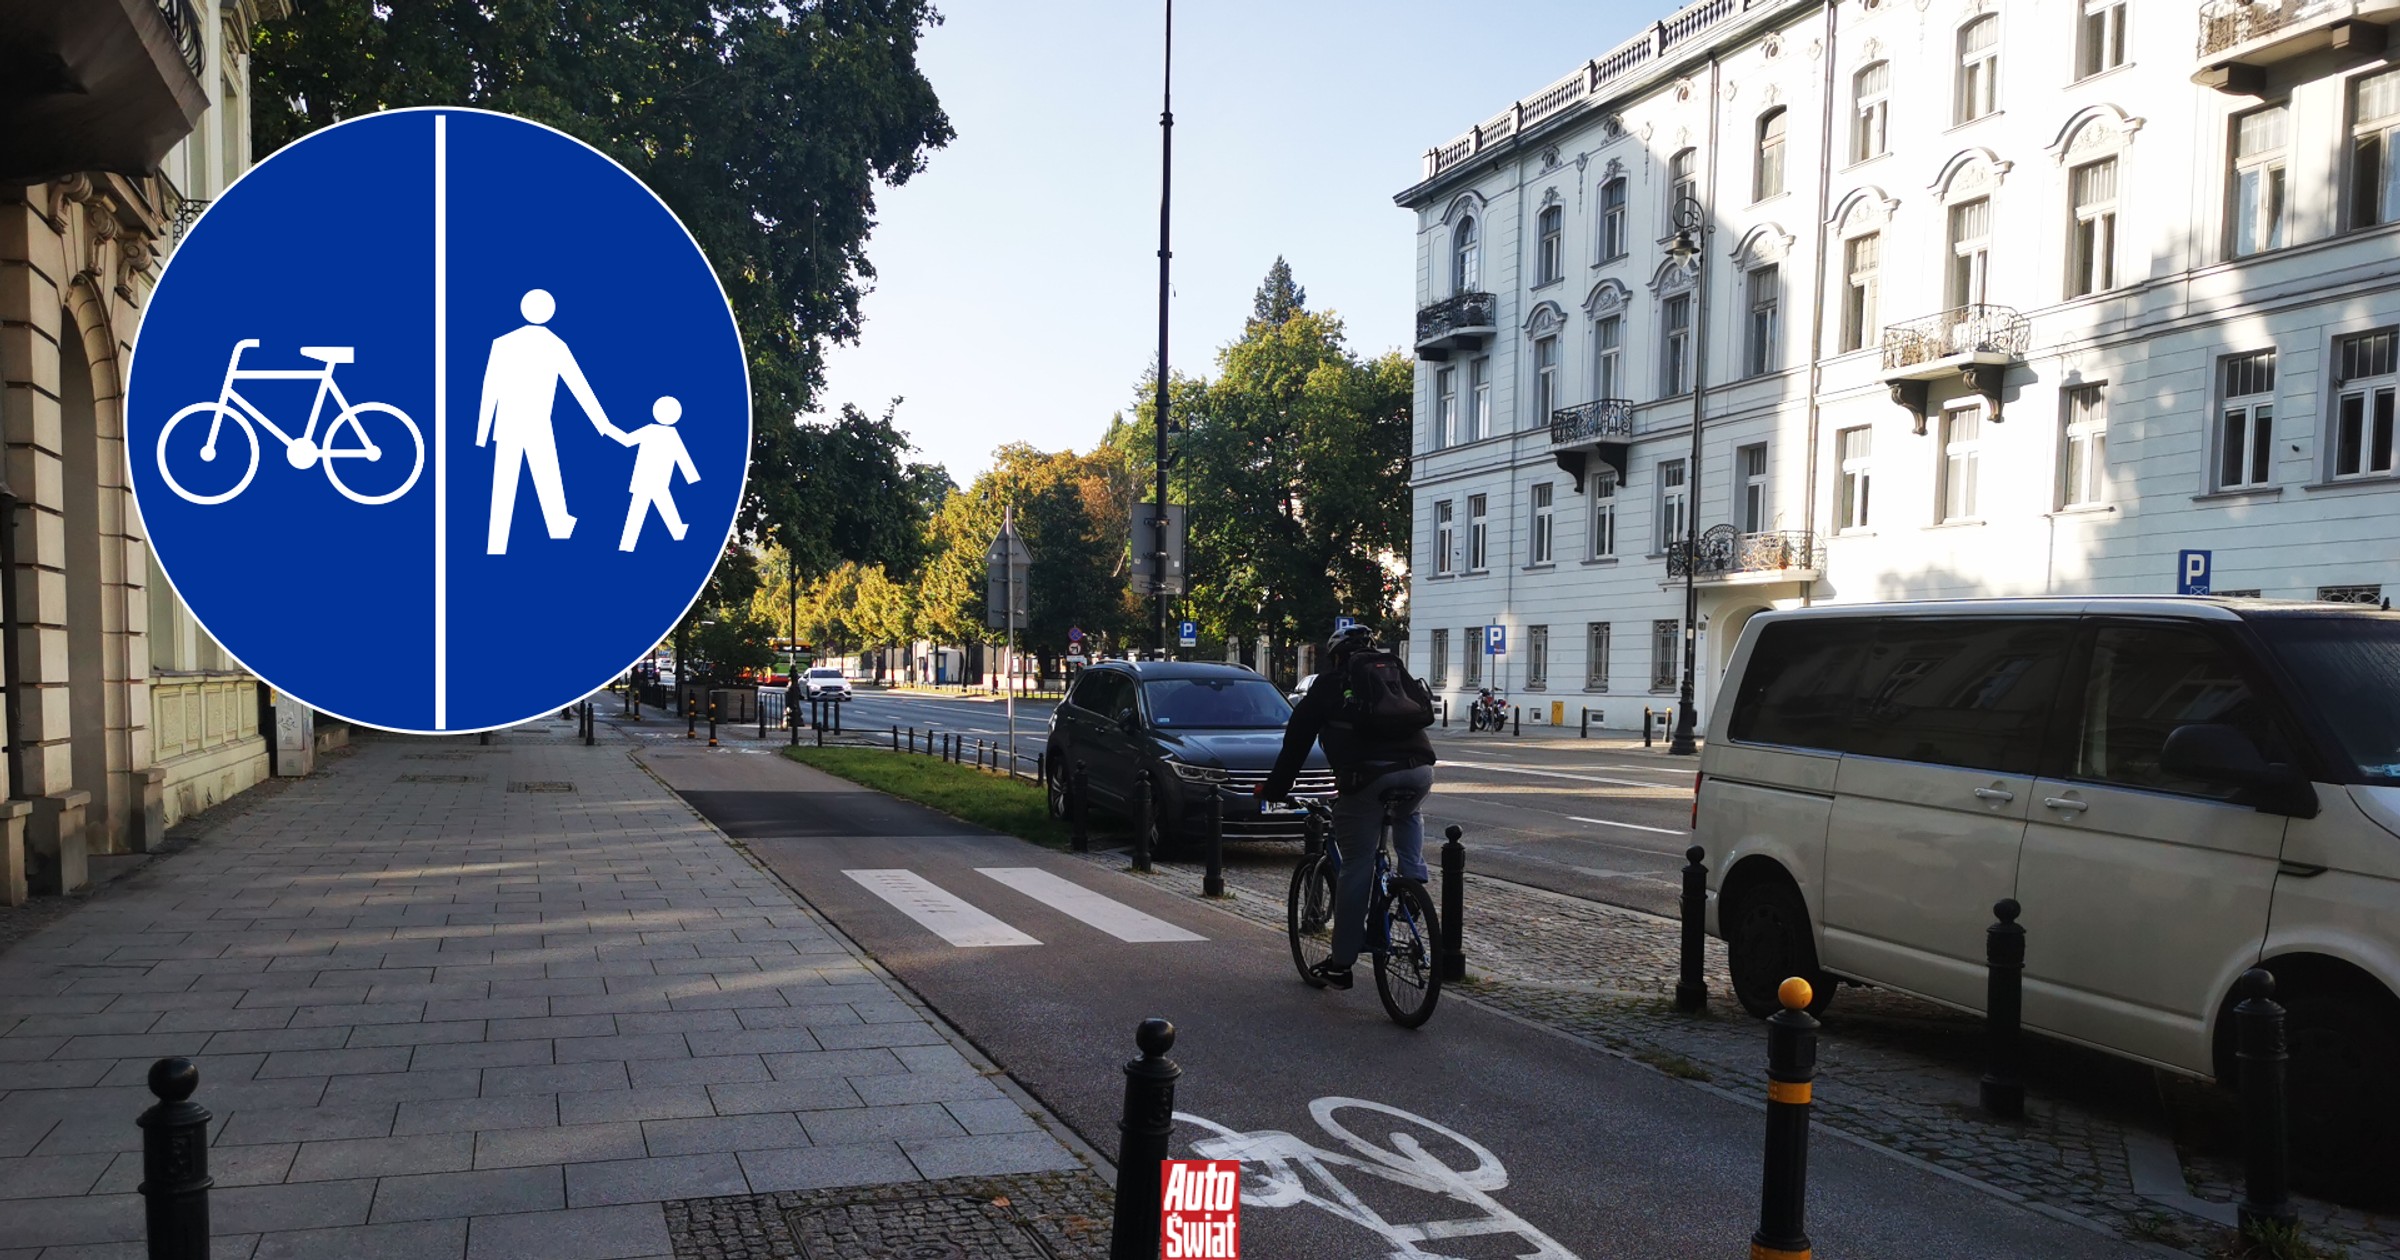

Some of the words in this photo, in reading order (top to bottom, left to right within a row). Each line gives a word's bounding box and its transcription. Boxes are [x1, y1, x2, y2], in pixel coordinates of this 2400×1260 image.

[2186, 554, 2205, 585] P
[1183, 622, 1193, 636] P
[1490, 627, 1502, 646] P
